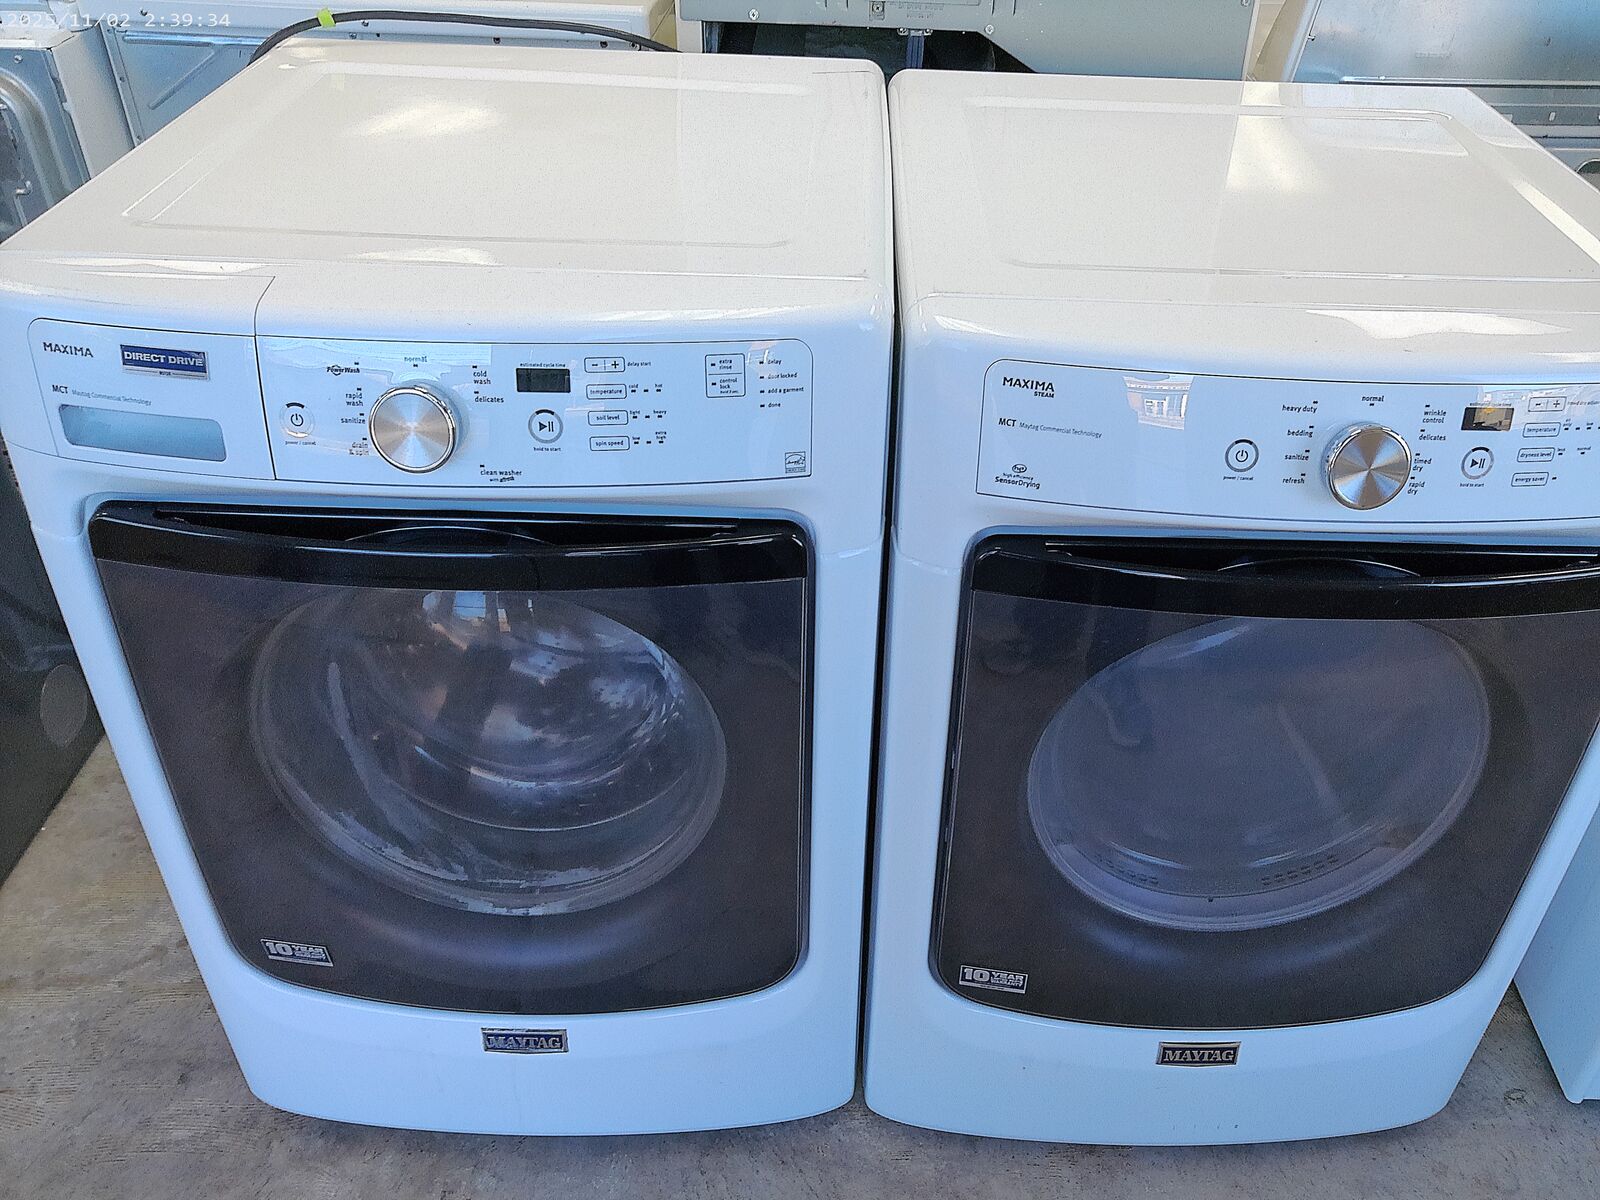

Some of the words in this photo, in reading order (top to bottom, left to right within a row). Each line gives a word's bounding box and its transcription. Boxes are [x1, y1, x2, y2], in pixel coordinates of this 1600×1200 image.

[42, 342, 94, 358] MAXIMA
[123, 351, 167, 363] DIRECT
[168, 355, 204, 367] DRIVE
[327, 366, 360, 374] PowerWash
[1002, 376, 1055, 393] MAXIMA
[52, 384, 69, 394] MCT
[783, 386, 804, 394] garment
[345, 392, 363, 400] rapid
[1034, 391, 1055, 399] STEAM
[1281, 404, 1301, 413] heavy
[1301, 405, 1318, 414] duty
[1423, 409, 1447, 417] wrinkle
[340, 417, 366, 425] sanitize
[998, 417, 1017, 428] MCT
[1019, 421, 1039, 431] Maytag
[1039, 424, 1072, 434] Commercial
[1072, 427, 1103, 439] Technology
[1287, 429, 1314, 438] bedding
[352, 441, 368, 449] drain
[1284, 453, 1310, 461] sanitize
[1519, 452, 1540, 460] dryness
[1413, 457, 1432, 465] timed
[1412, 465, 1423, 473] dry
[994, 476, 1041, 490] SensorDrying
[1282, 476, 1305, 485] refresh
[1514, 476, 1532, 484] energy
[1408, 481, 1425, 489] rapid
[1407, 488, 1418, 496] dry
[265, 942, 293, 956] 10
[963, 967, 990, 982] 10
[991, 971, 1024, 981] YEAR
[486, 1036, 561, 1049] MAYTAG
[1163, 1050, 1235, 1062] MAYTAG
